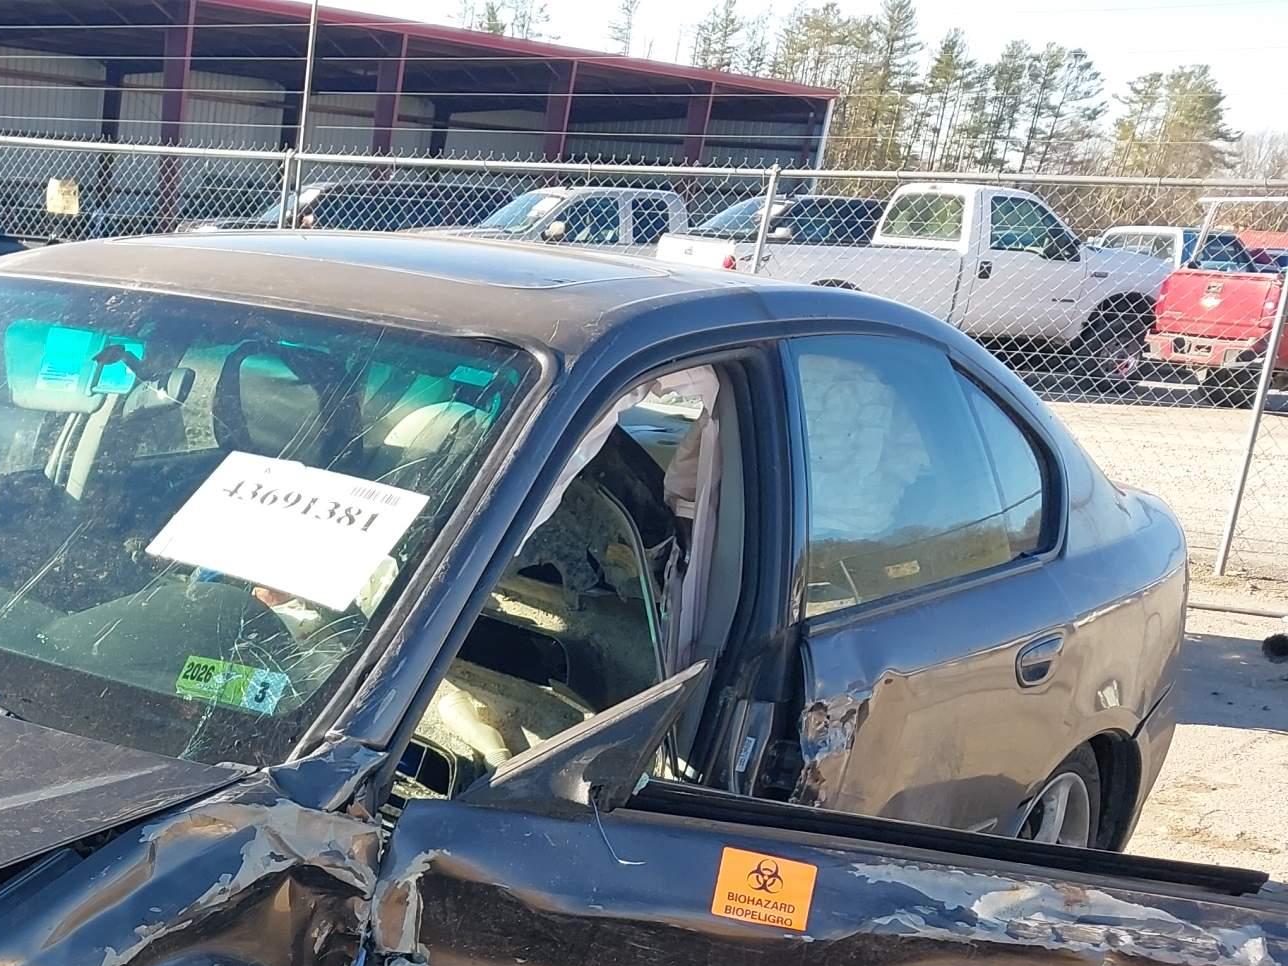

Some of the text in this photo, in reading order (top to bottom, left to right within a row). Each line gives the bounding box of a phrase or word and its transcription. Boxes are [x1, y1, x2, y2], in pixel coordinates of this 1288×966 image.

[222, 480, 380, 532] 43691381
[182, 662, 215, 684] 2026
[254, 682, 270, 703] 3
[727, 892, 796, 914] BIOHAZARD
[724, 905, 793, 927] BIOPELIGRO
